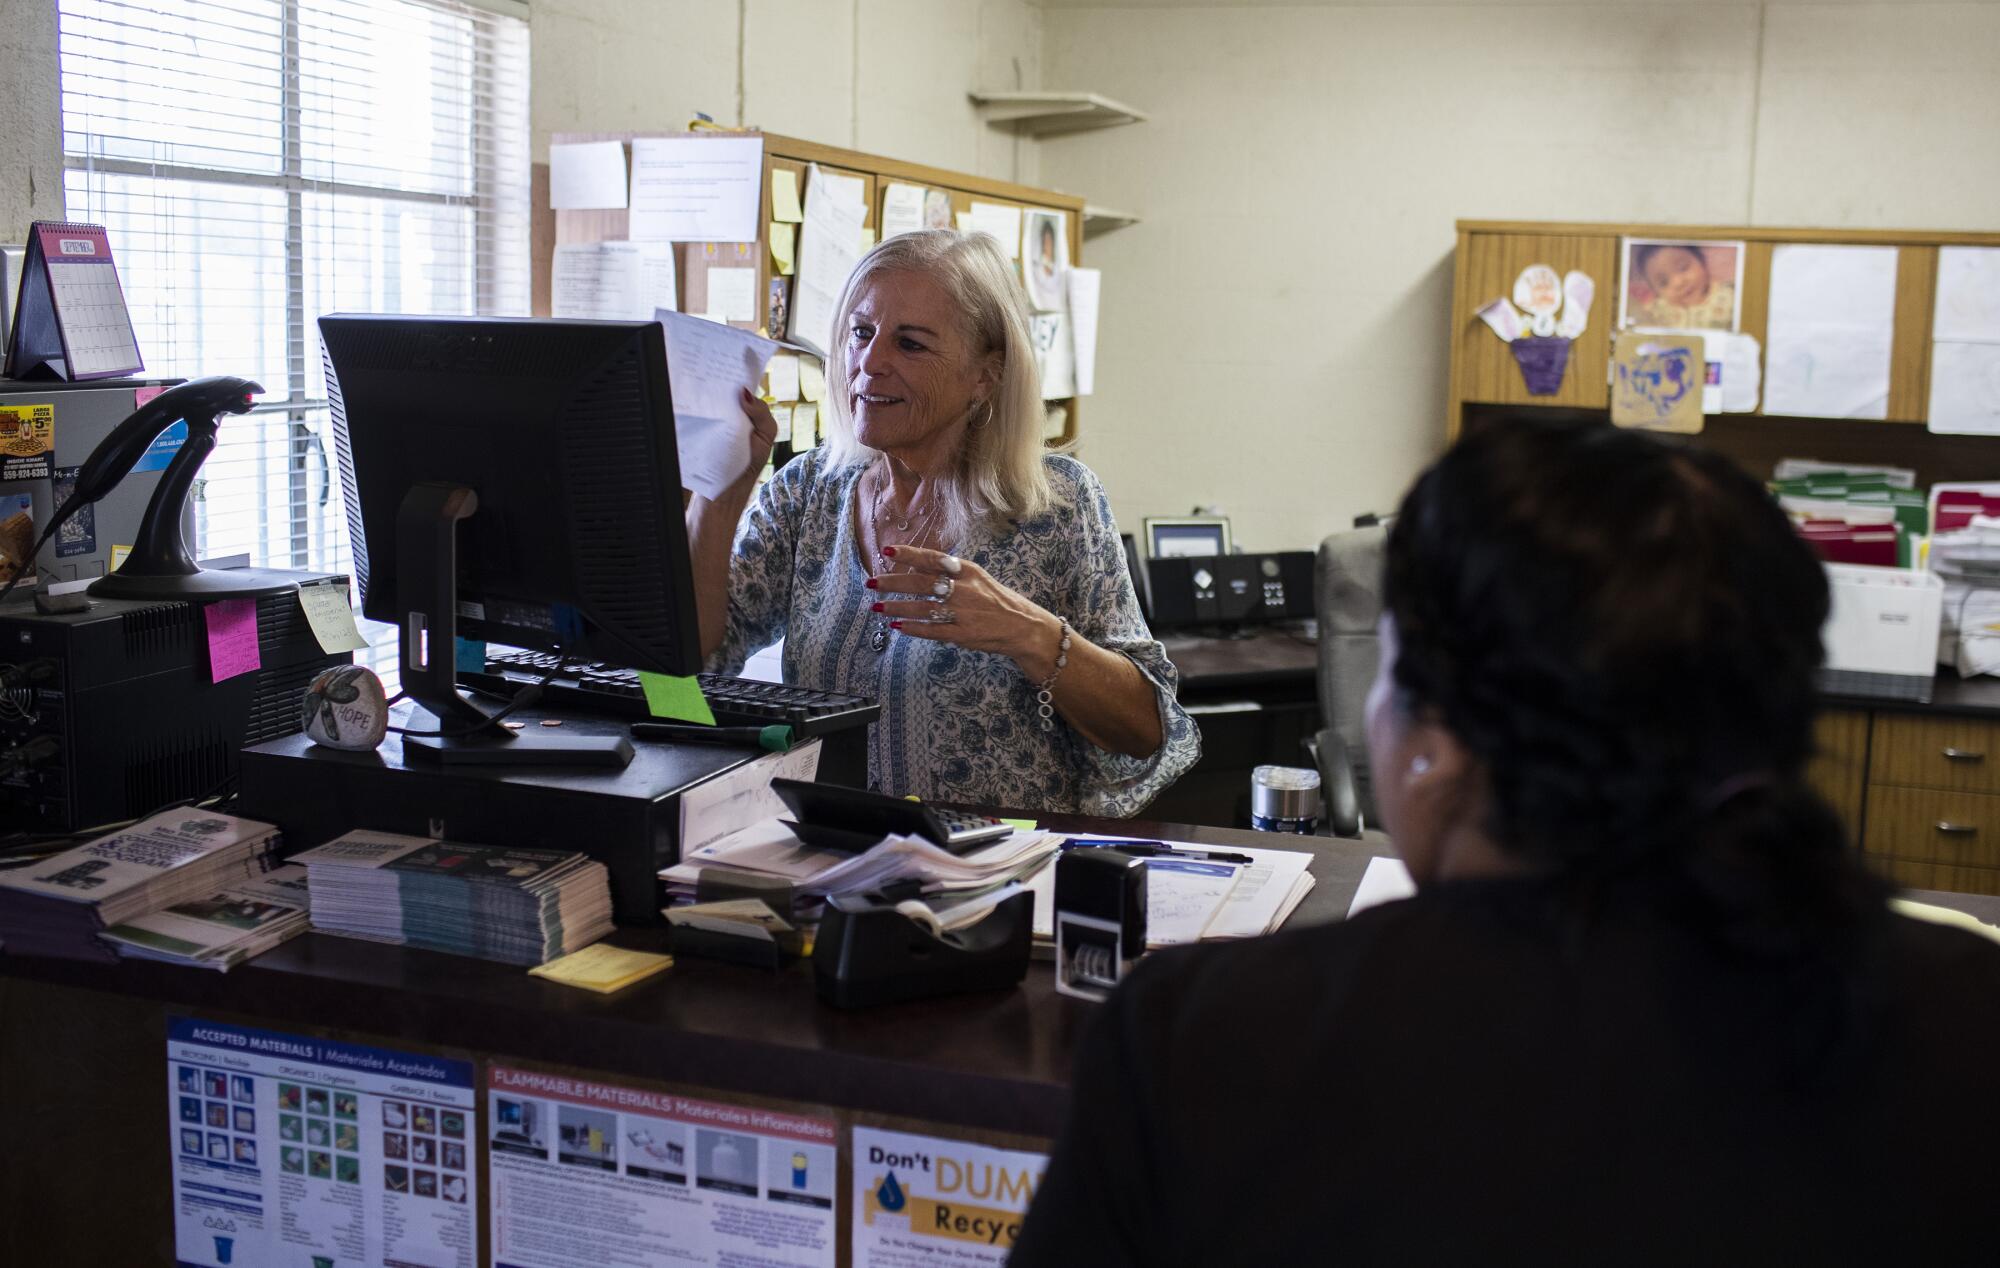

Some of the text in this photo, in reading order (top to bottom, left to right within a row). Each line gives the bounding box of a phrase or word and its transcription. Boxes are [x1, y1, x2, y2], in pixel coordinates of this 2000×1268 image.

[337, 707, 371, 730] HOPE
[193, 1029, 447, 1079] ACCEPTED MATERIALS Materiales Aceptados
[494, 1070, 834, 1139] FLAMMABLE MATERIALS Materiales Inflamables
[869, 1147, 1045, 1203] Don't DUM
[935, 1204, 1020, 1246] Recyc
